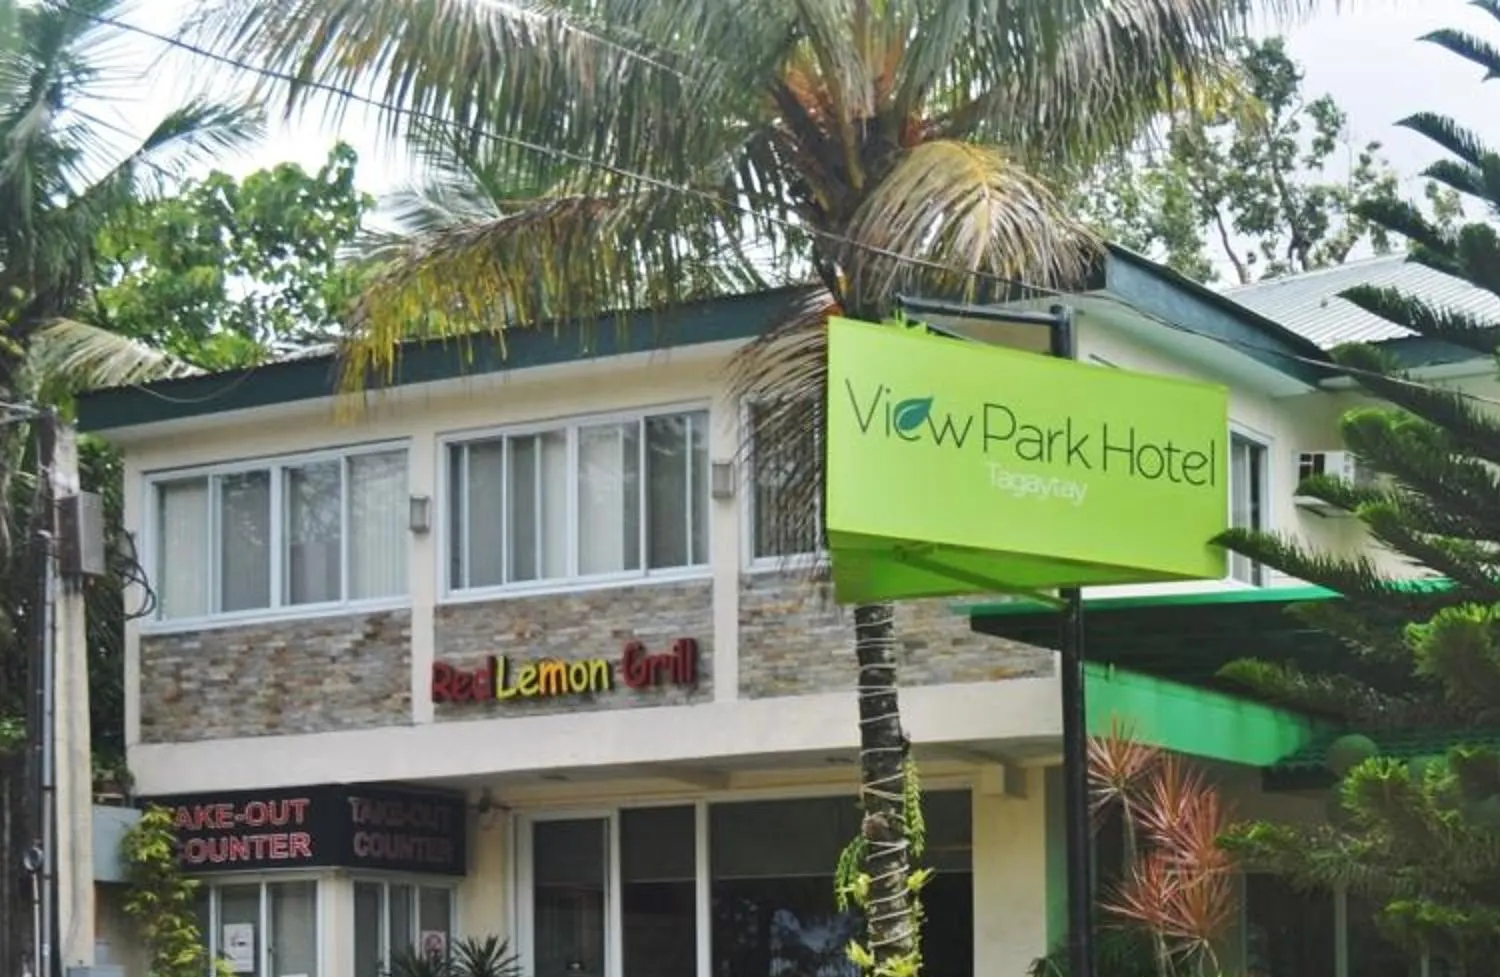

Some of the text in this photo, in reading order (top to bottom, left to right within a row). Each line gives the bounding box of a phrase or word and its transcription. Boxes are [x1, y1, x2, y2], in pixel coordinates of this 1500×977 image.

[844, 377, 1217, 488] View Park Hotel
[986, 463, 1089, 506] Tagaytay
[431, 637, 698, 703] Red Lemon Grill
[172, 798, 310, 831] AKE-OUT
[352, 831, 454, 865] COUNTER
